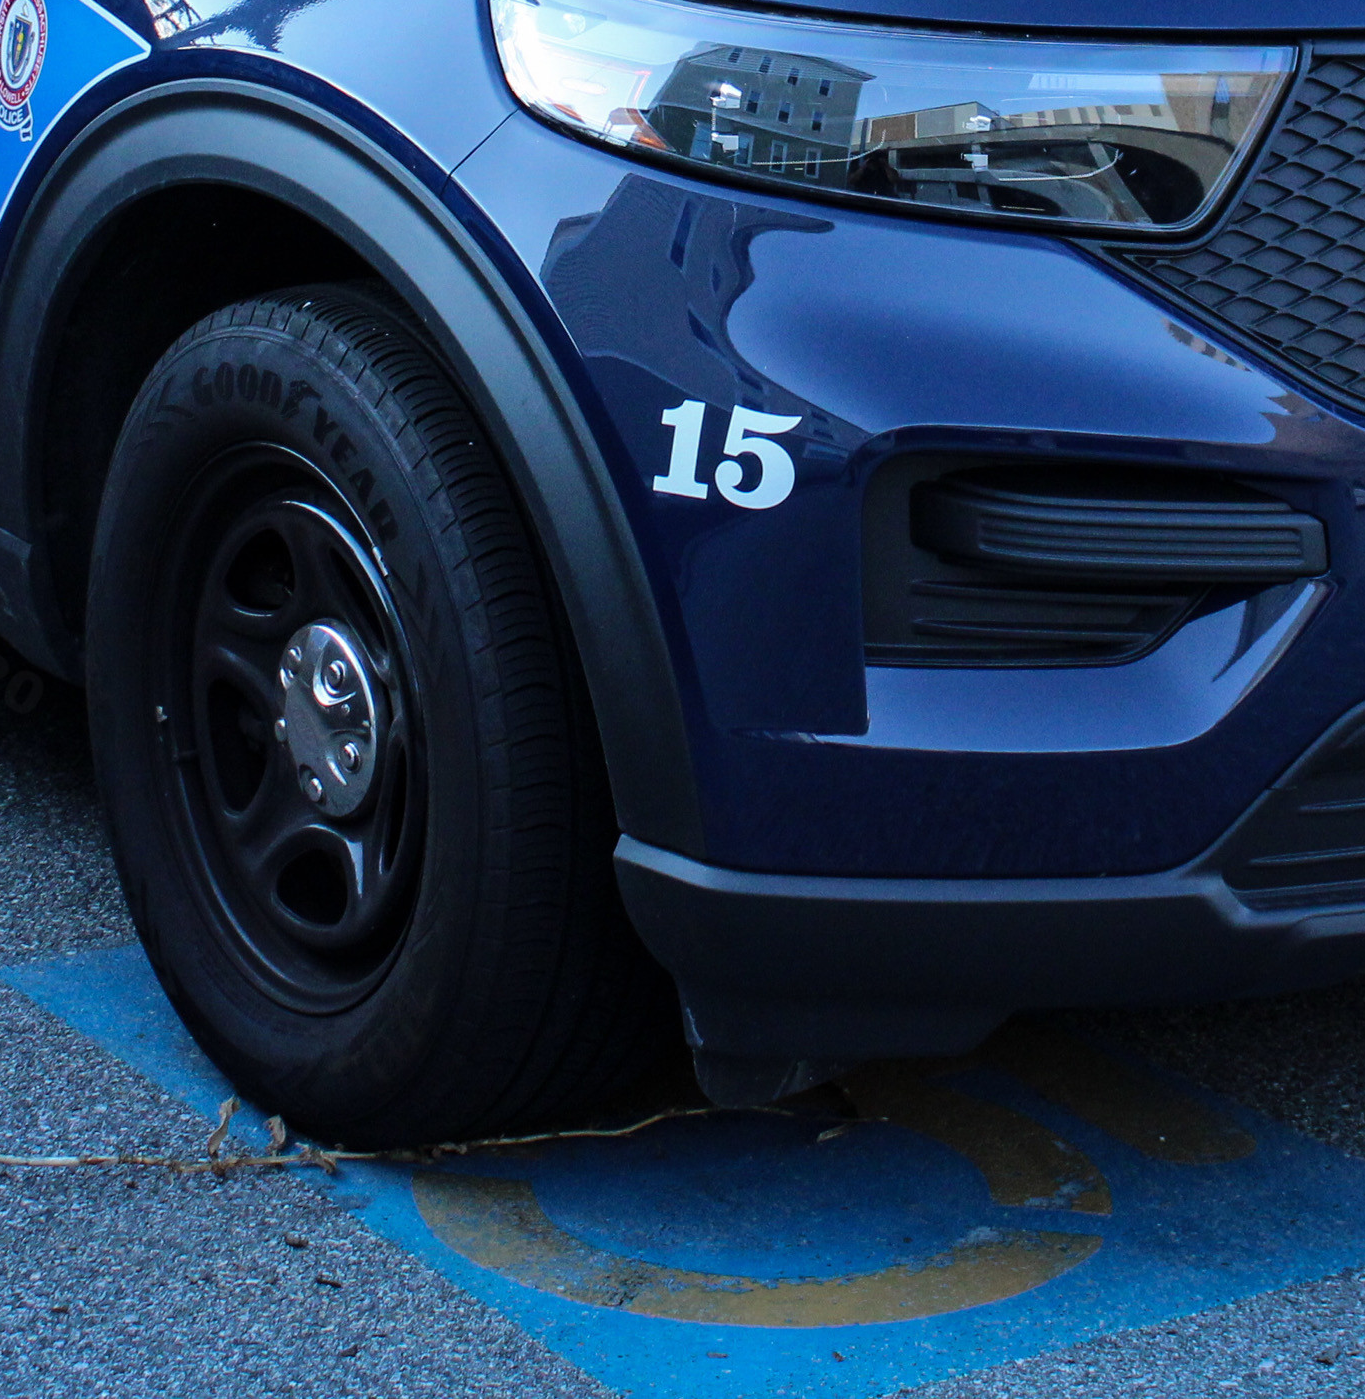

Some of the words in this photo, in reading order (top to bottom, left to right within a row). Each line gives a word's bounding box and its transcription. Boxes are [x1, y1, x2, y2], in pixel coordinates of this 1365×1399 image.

[0, 82, 23, 104] LOWELL
[191, 362, 399, 543] GOODYEAR
[652, 399, 795, 510] 15
